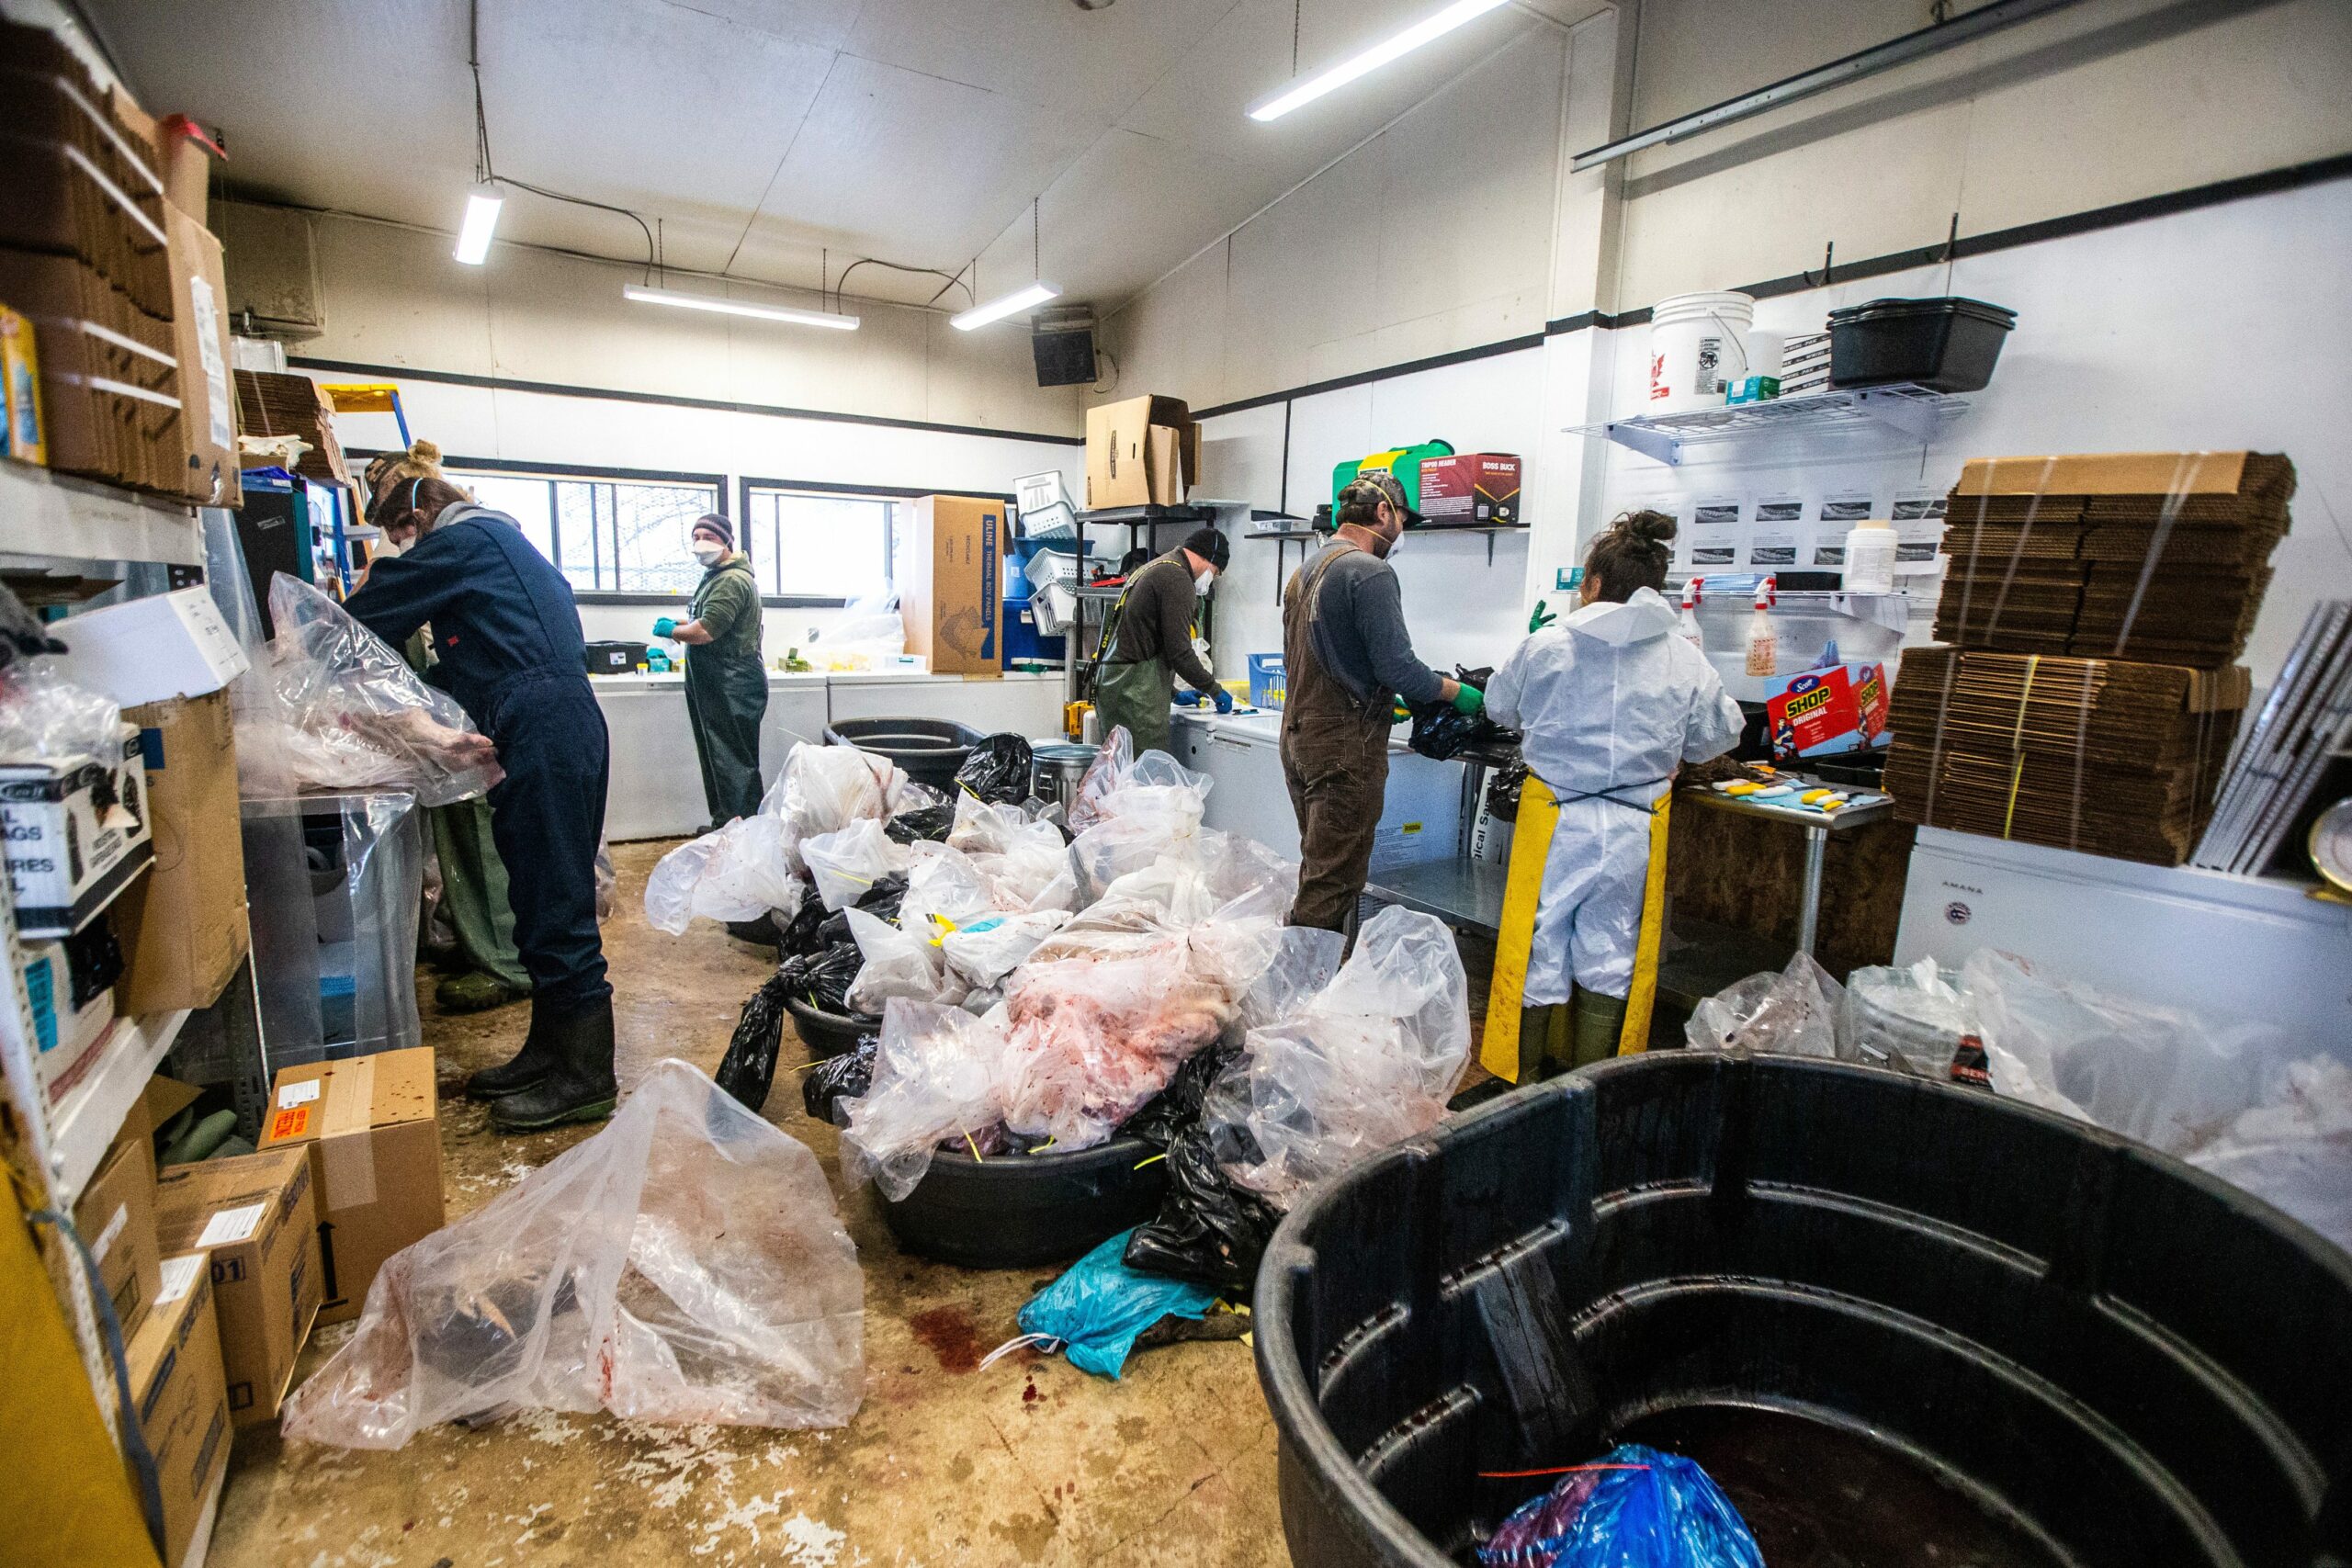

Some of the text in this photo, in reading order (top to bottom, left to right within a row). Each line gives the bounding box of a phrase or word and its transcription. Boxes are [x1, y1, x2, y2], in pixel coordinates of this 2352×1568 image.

[1499, 463, 1515, 471] BUCK
[985, 520, 993, 547] ULINE
[1796, 678, 1814, 693] Scott
[1787, 687, 1830, 717] SHOP
[1792, 706, 1827, 727] ORIGINAL
[1942, 880, 1984, 895] AMANA
